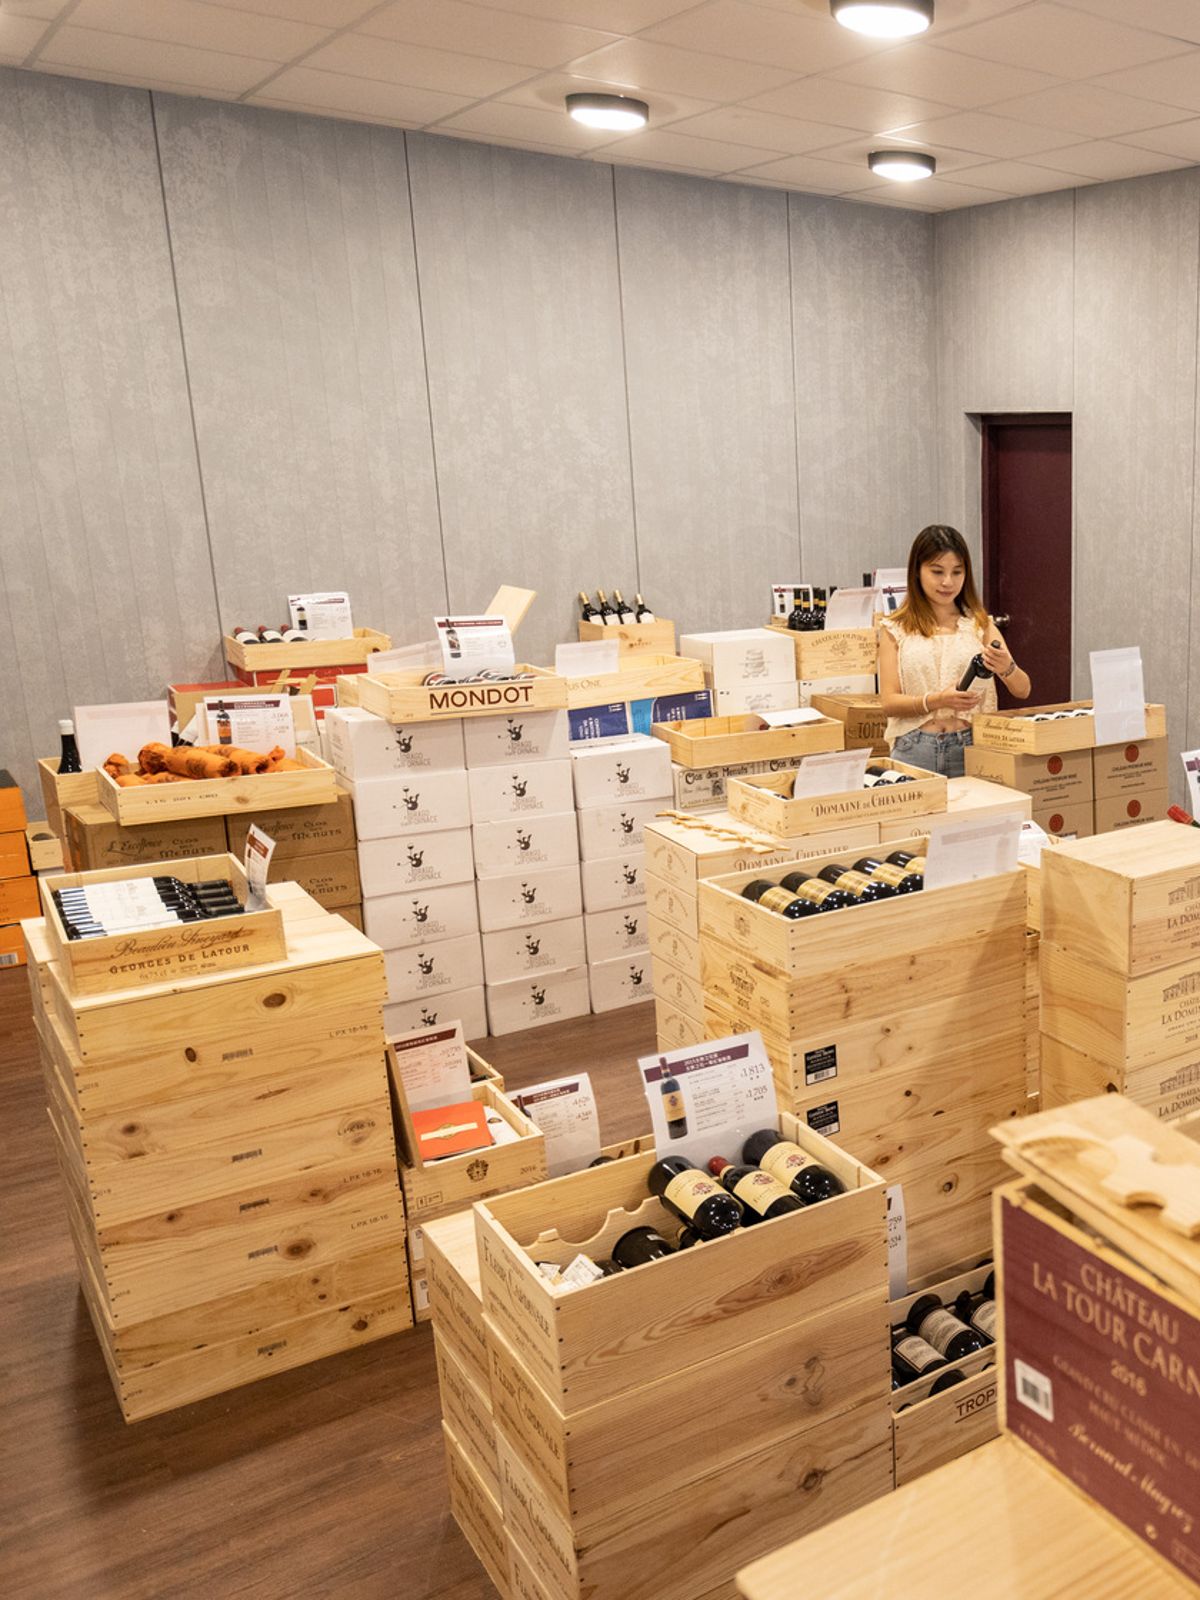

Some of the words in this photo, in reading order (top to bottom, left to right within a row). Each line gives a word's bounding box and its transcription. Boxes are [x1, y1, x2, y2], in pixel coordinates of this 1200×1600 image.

[429, 685, 534, 710] MONDOT
[109, 956, 172, 975] GEORGES
[178, 952, 196, 964] DE
[202, 943, 250, 960] LATOUR
[1161, 1013, 1173, 1025] LA
[1032, 1261, 1057, 1302] LA
[1062, 1279, 1129, 1351] TOUR
[1080, 1262, 1180, 1345] CHÂTEAU
[956, 1388, 996, 1417] TROP
